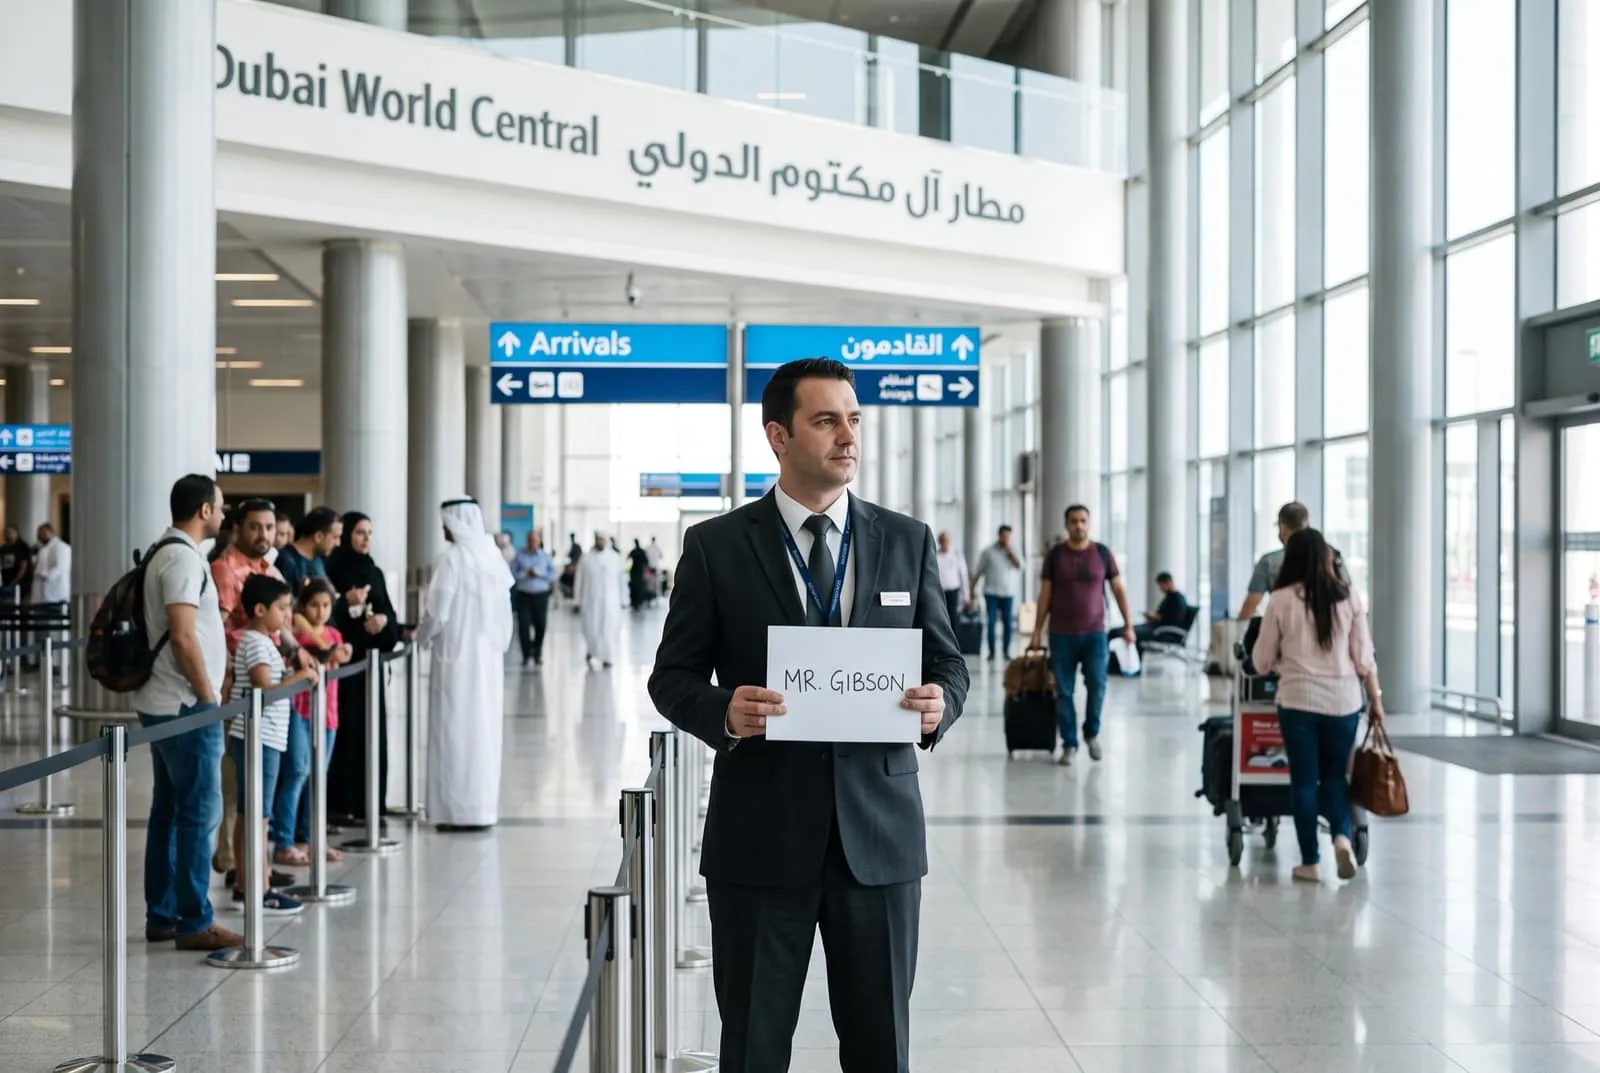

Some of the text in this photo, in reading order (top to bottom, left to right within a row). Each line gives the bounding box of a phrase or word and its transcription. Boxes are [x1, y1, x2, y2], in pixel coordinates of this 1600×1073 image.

[216, 43, 598, 156] Dubai World Central
[628, 131, 1025, 224] مطار آل مكتوم الدولي
[529, 330, 632, 356] Arrivals
[841, 333, 943, 360] القادمون
[784, 668, 905, 695] MR. GIBSON
